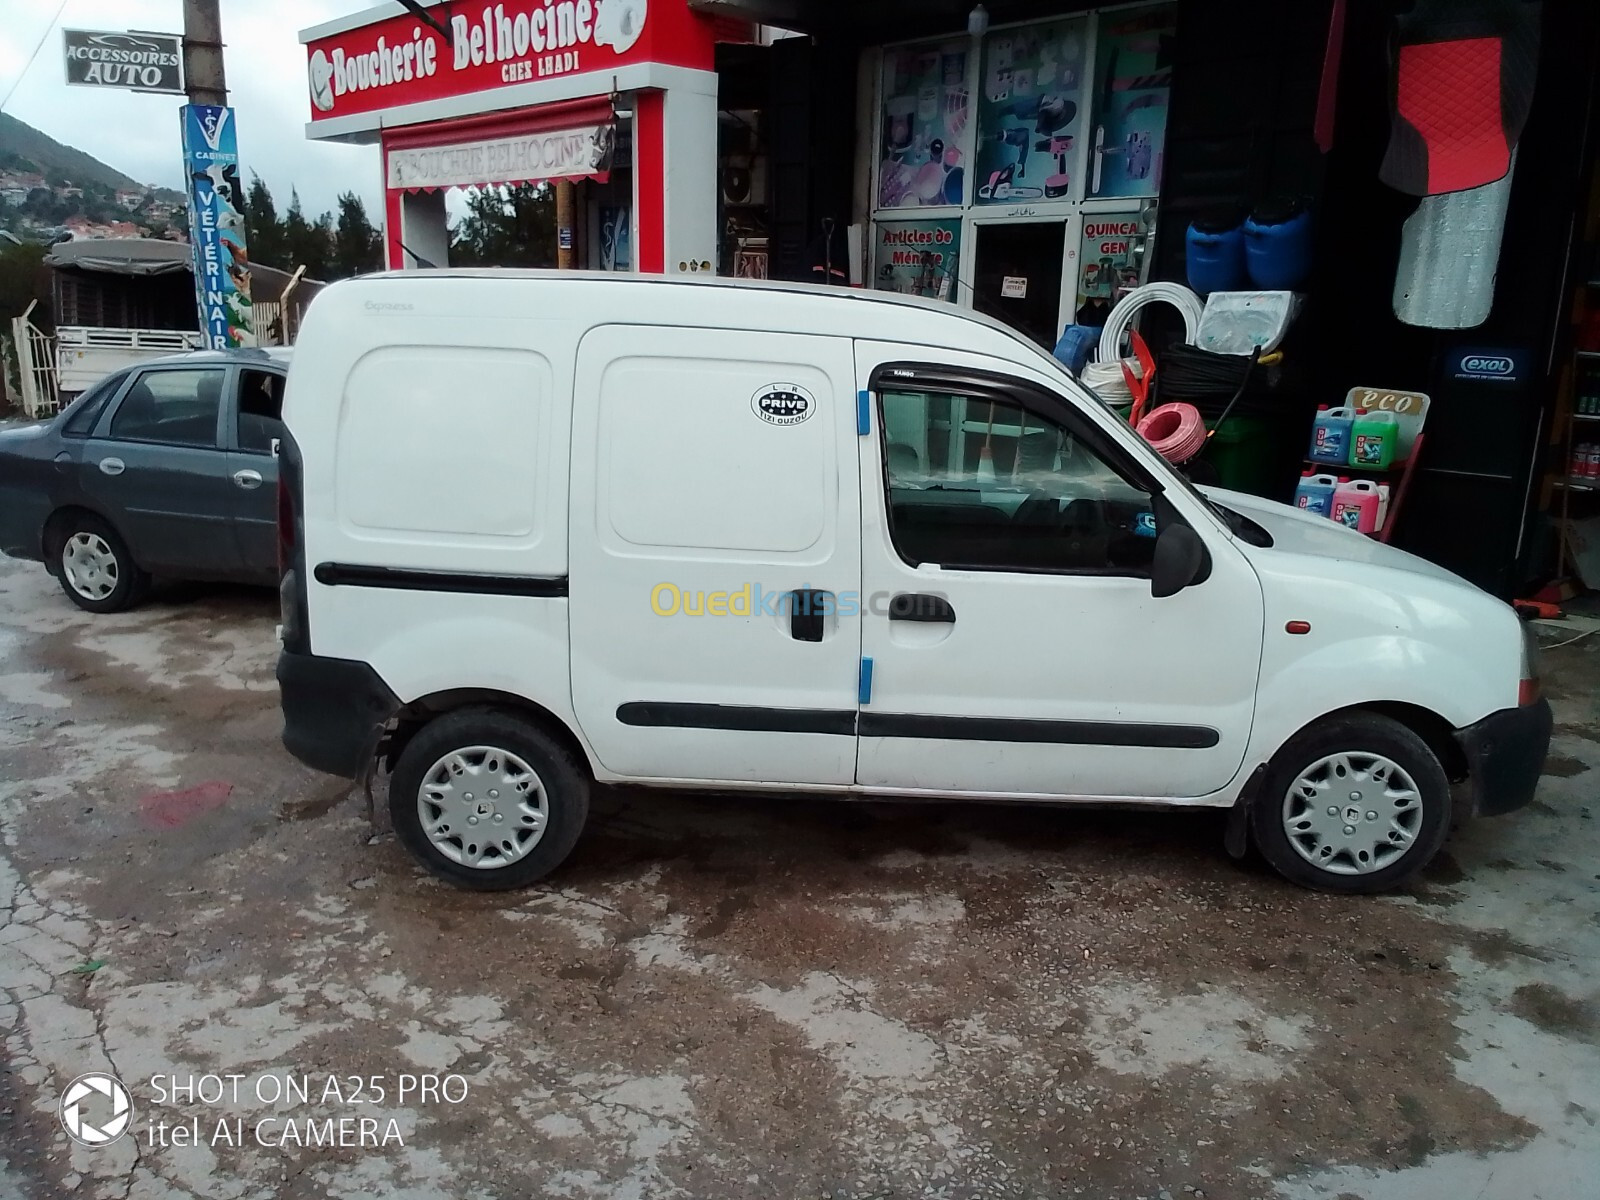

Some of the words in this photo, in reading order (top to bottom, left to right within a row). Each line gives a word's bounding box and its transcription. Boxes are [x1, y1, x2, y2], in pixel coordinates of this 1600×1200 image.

[66, 45, 180, 66] ACCESSOIRES
[332, 26, 437, 97] Boucherie
[451, 0, 593, 71] Belhocine
[84, 61, 162, 87] AUTO
[537, 50, 580, 77] LHADI
[195, 151, 237, 161] CABINET
[487, 133, 585, 174] BELHOCINE
[883, 228, 933, 244] Articles
[935, 228, 952, 244] de
[1085, 222, 1137, 239] QUINCA
[760, 410, 776, 423] TIZI
[777, 411, 808, 424] OUZOU
